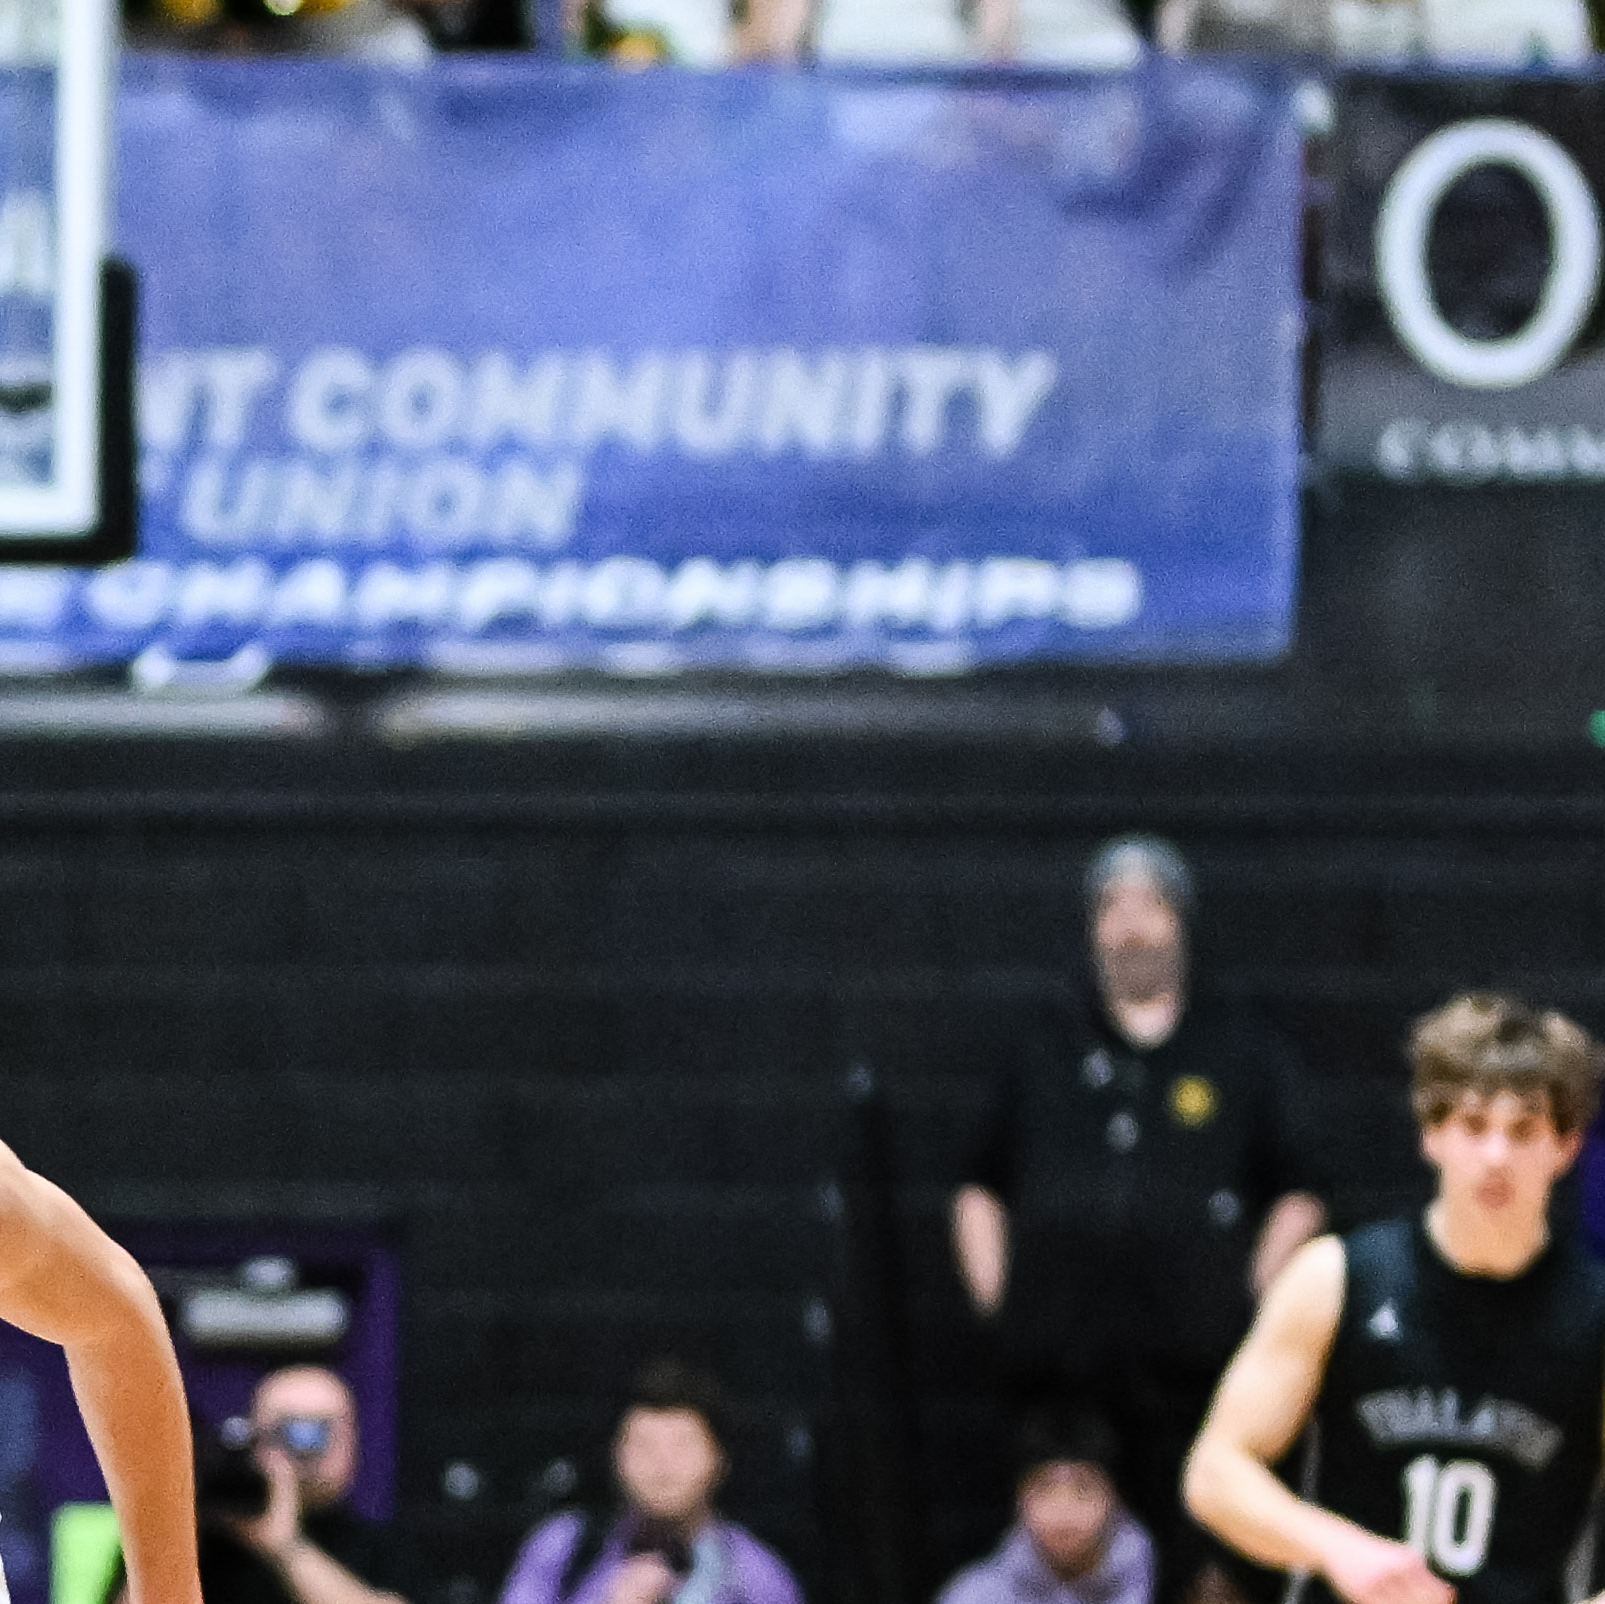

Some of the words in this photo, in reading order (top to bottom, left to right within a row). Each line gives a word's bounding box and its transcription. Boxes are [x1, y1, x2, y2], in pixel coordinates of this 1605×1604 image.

[287, 346, 1061, 458] COMMUNITY
[185, 454, 587, 548] UNION
[87, 558, 1143, 630] CHAMPIONSHIPS
[1401, 1452, 1499, 1578] 10
